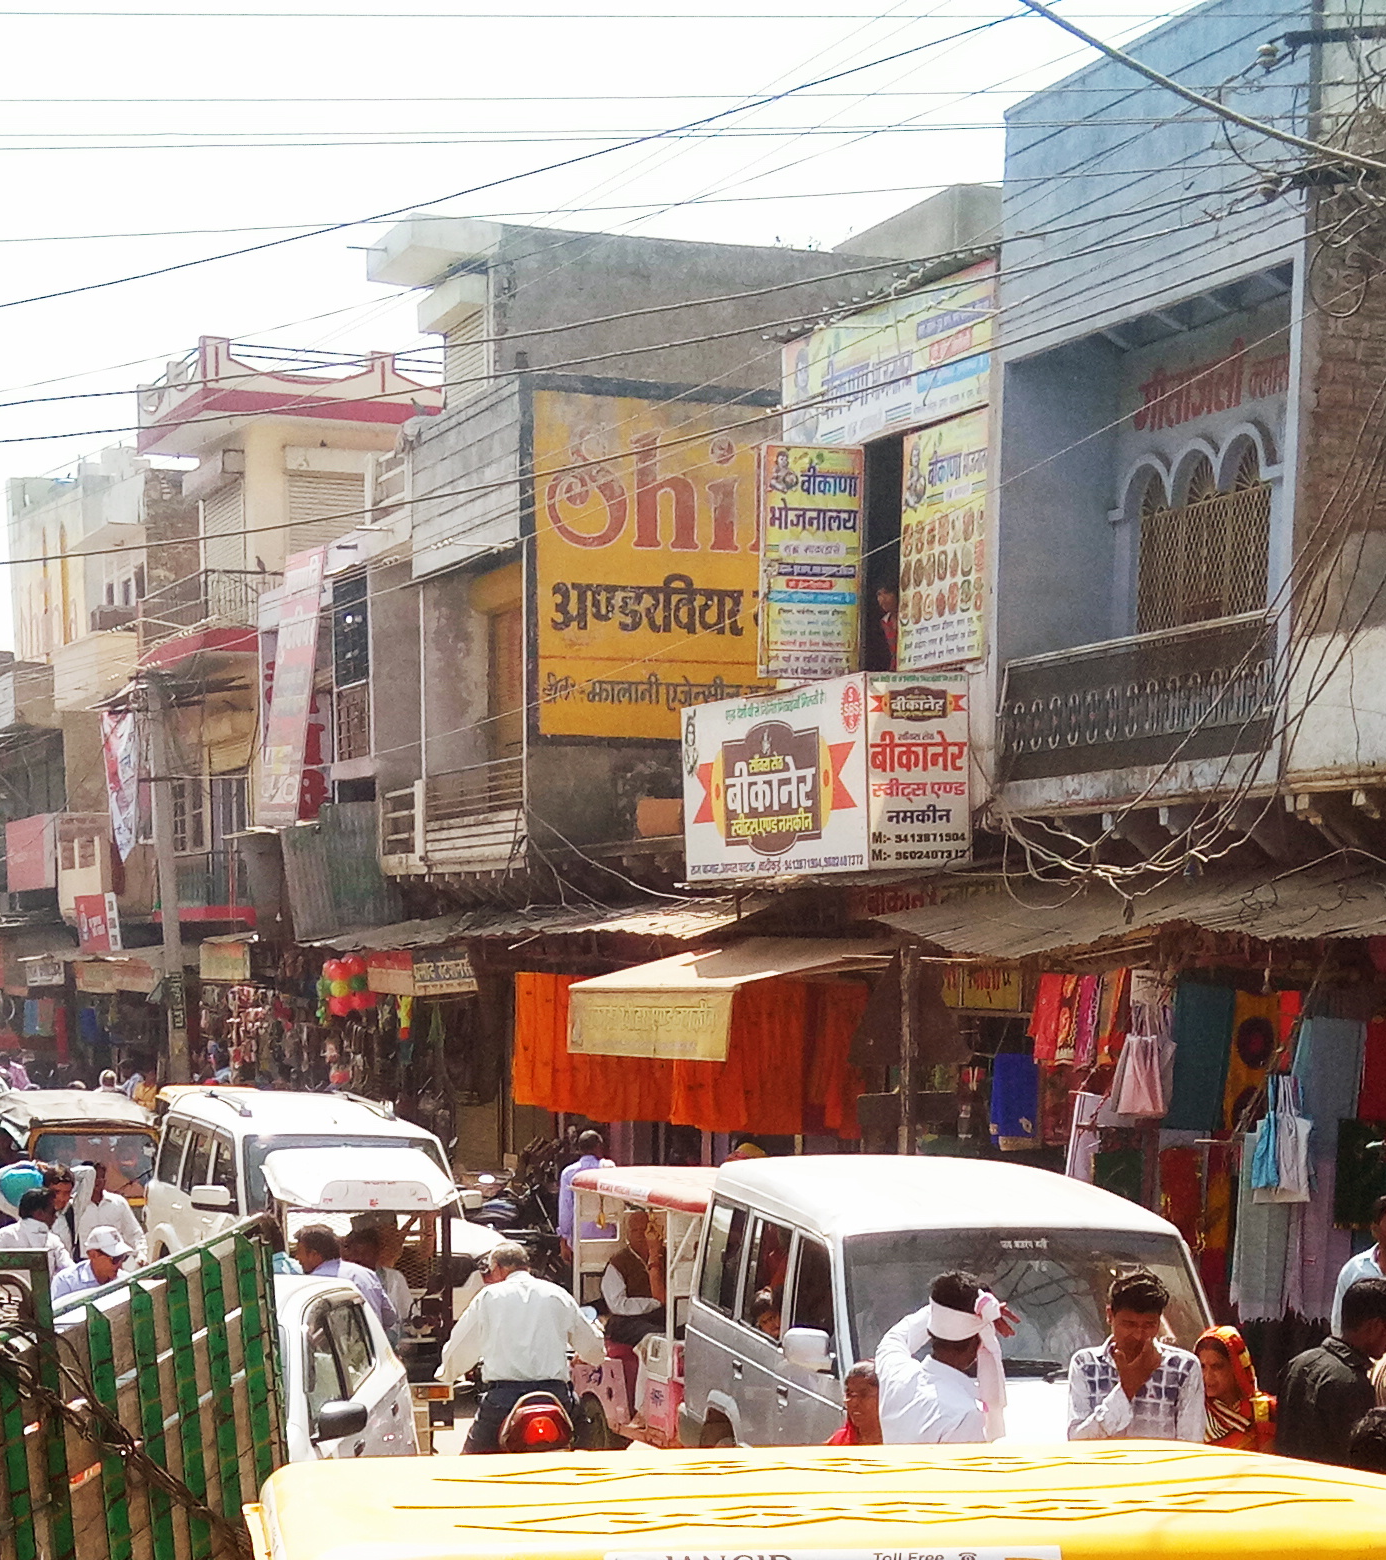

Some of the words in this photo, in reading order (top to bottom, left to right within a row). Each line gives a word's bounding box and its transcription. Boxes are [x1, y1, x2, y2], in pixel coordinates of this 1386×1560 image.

[547, 427, 760, 551] Shi
[800, 464, 858, 497] बीकाणा
[769, 498, 858, 532] भोजनालय
[551, 573, 744, 636] अण्डरवियर
[890, 695, 945, 711] बीकानेर
[870, 730, 967, 772] बीकानेर
[724, 756, 816, 814] बीकानेर
[872, 778, 928, 803] स्वीट्स
[931, 781, 966, 799] एण्ड
[778, 808, 813, 832] नमकीन
[887, 804, 952, 825] नमकीन
[872, 832, 891, 845] M:-
[872, 849, 891, 862] M:-
